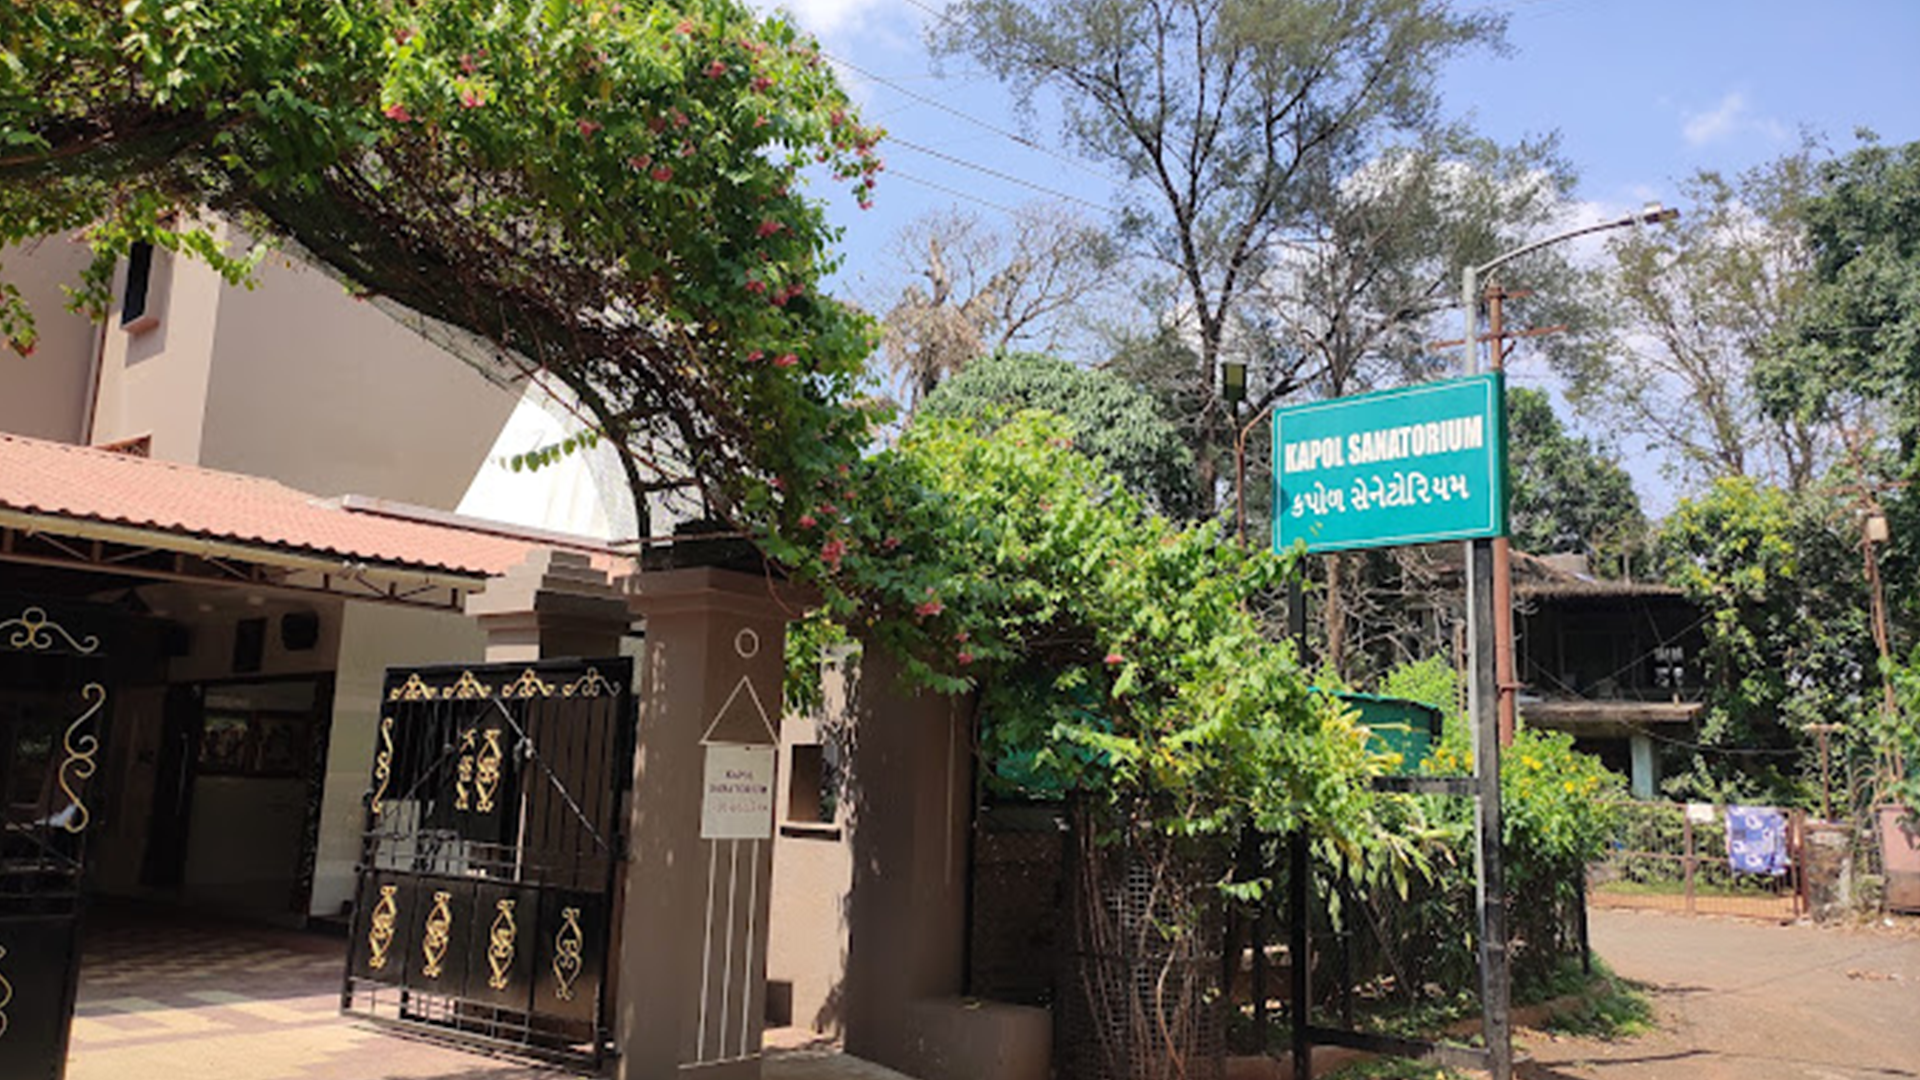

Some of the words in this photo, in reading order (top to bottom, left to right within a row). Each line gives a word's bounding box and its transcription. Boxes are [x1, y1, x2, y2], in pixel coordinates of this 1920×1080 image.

[1285, 437, 1344, 473] KAPOL
[1348, 415, 1483, 465] SANATORIUM
[1291, 481, 1346, 518] કપોળ
[1351, 471, 1470, 510] સેનેટોરિયમ
